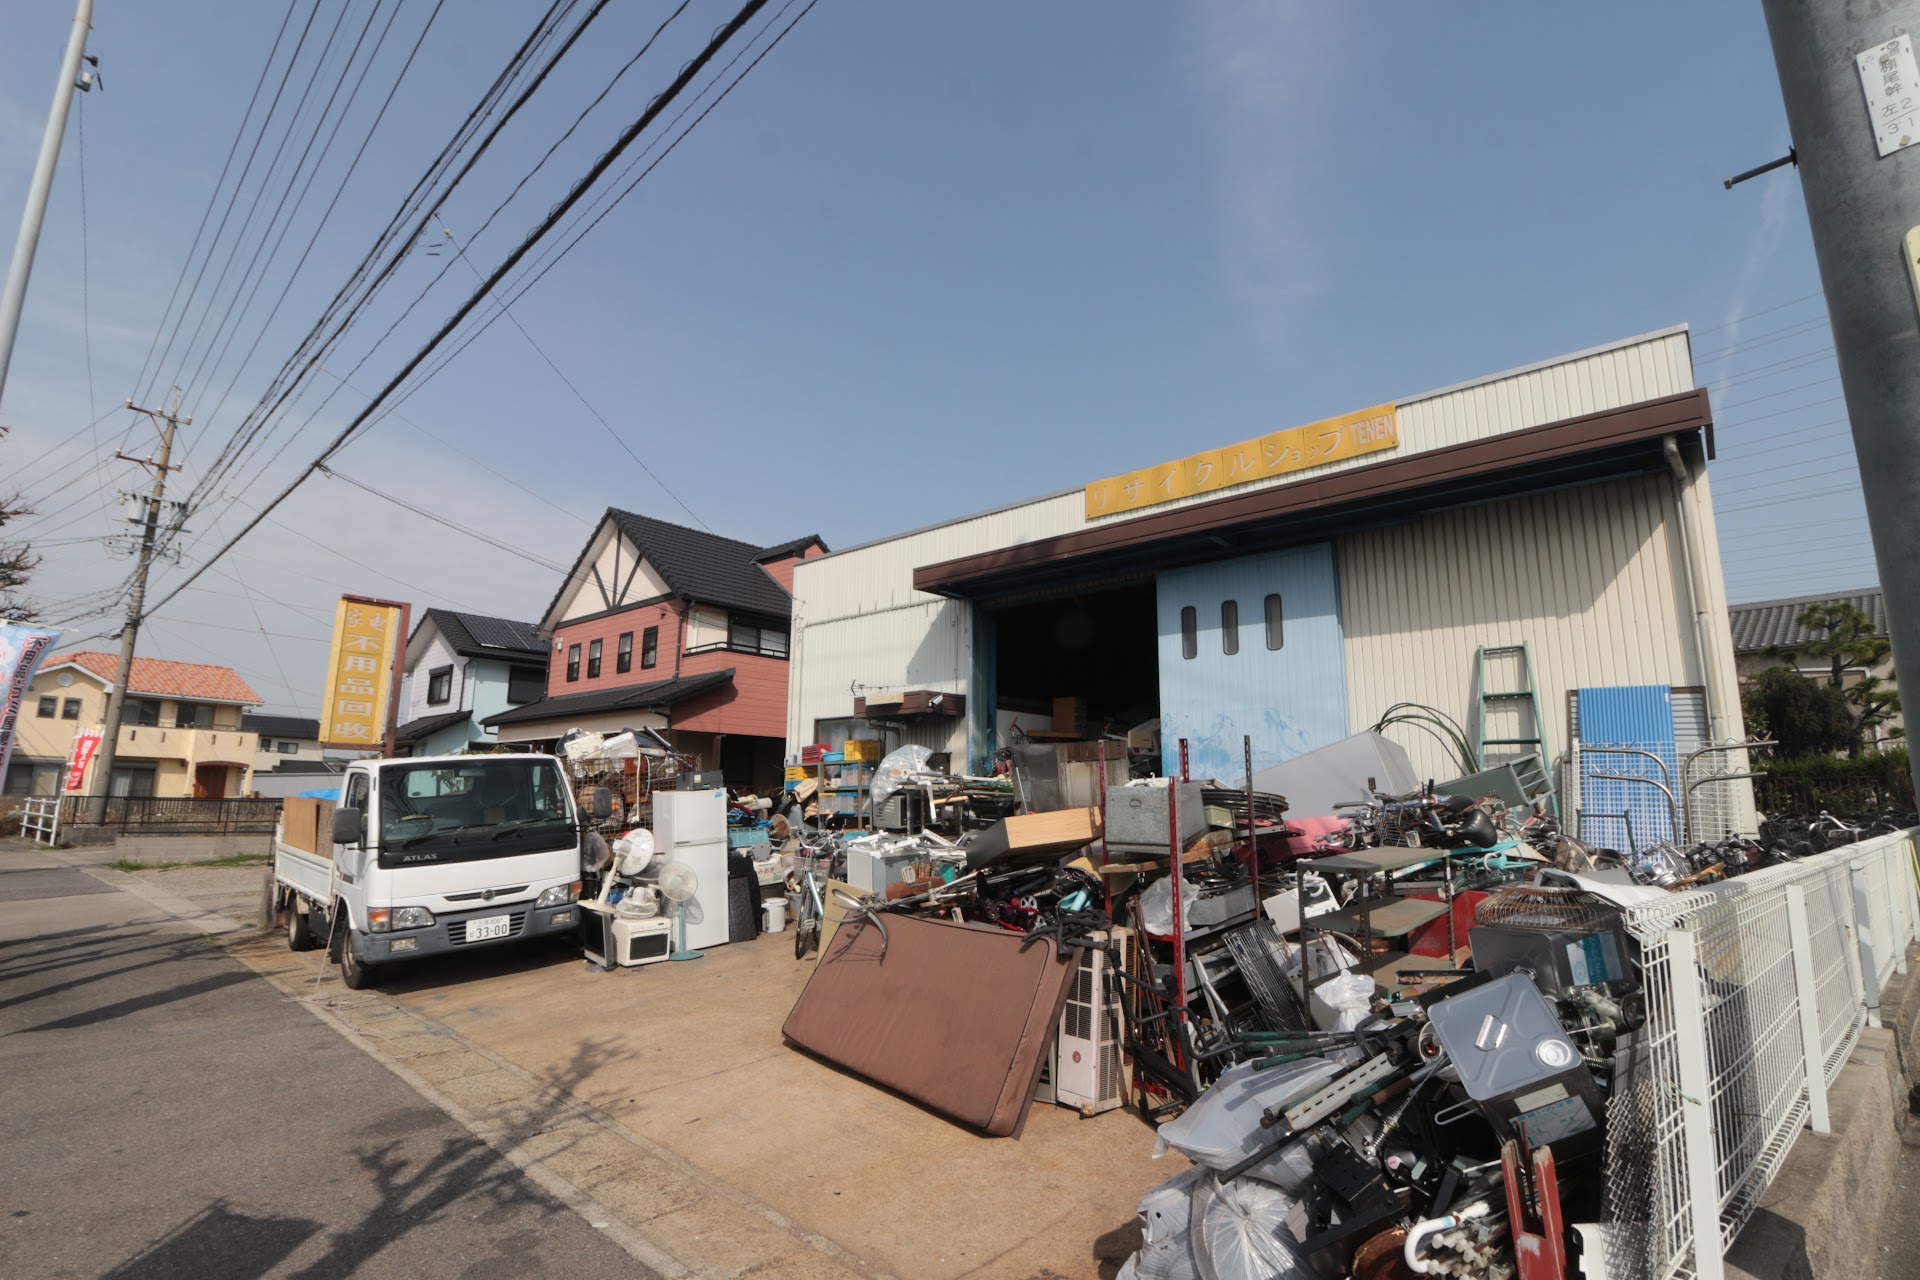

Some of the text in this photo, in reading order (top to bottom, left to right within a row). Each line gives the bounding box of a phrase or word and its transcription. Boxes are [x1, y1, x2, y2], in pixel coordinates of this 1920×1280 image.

[1094, 413, 1395, 509] リサイクルショップ TENEN
[403, 853, 438, 862] ATLAS
[476, 924, 508, 939] 33-00
